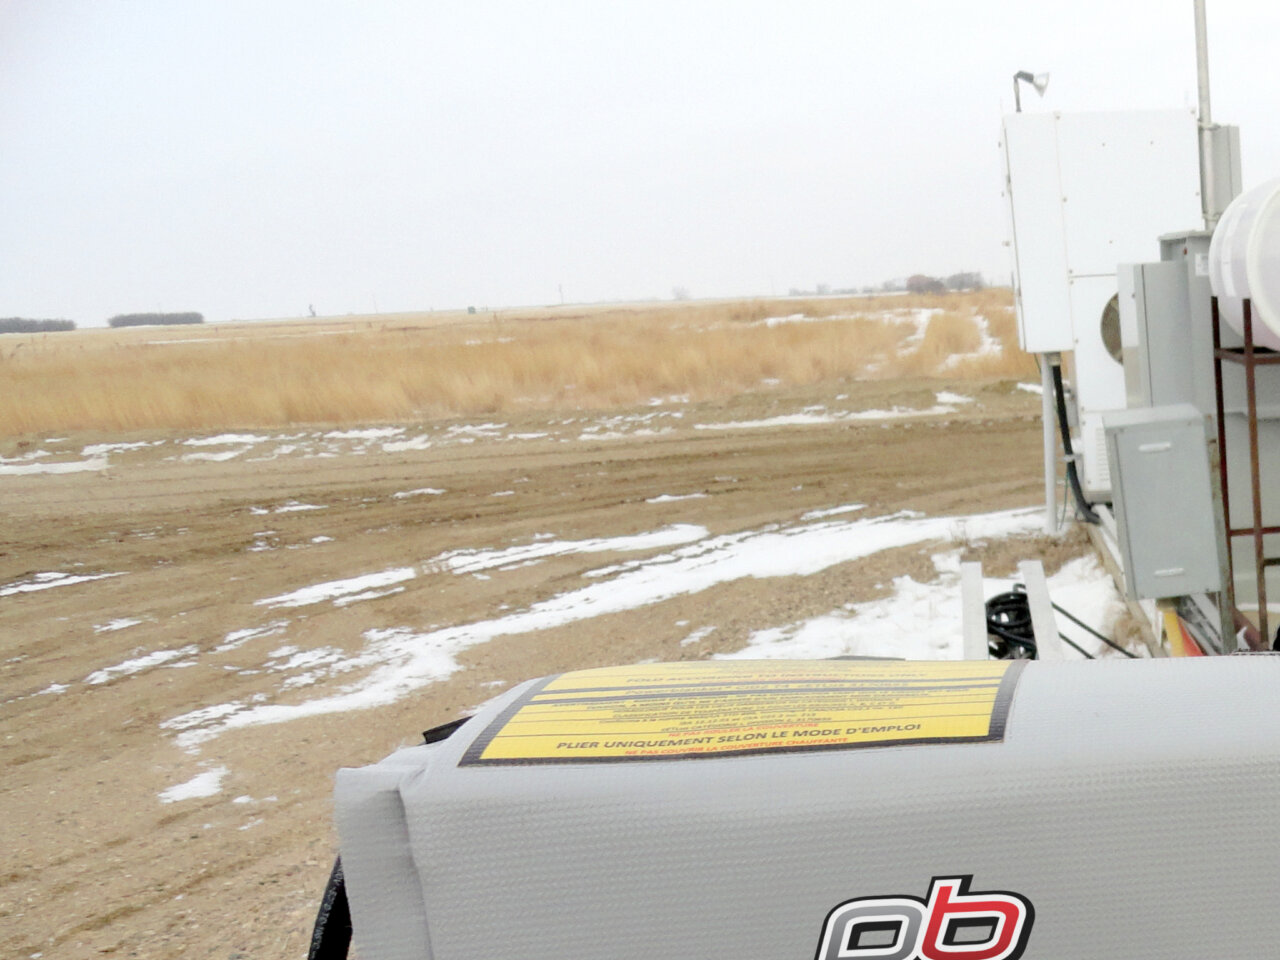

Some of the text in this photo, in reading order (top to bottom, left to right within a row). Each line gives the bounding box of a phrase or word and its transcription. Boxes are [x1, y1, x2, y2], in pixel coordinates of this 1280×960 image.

[556, 723, 921, 750] PLIER UNIQUEMENT SELON LE MODE D'EMPLOI
[720, 740, 784, 750] COUVERTURE
[785, 737, 848, 745] CHAUFFANTE
